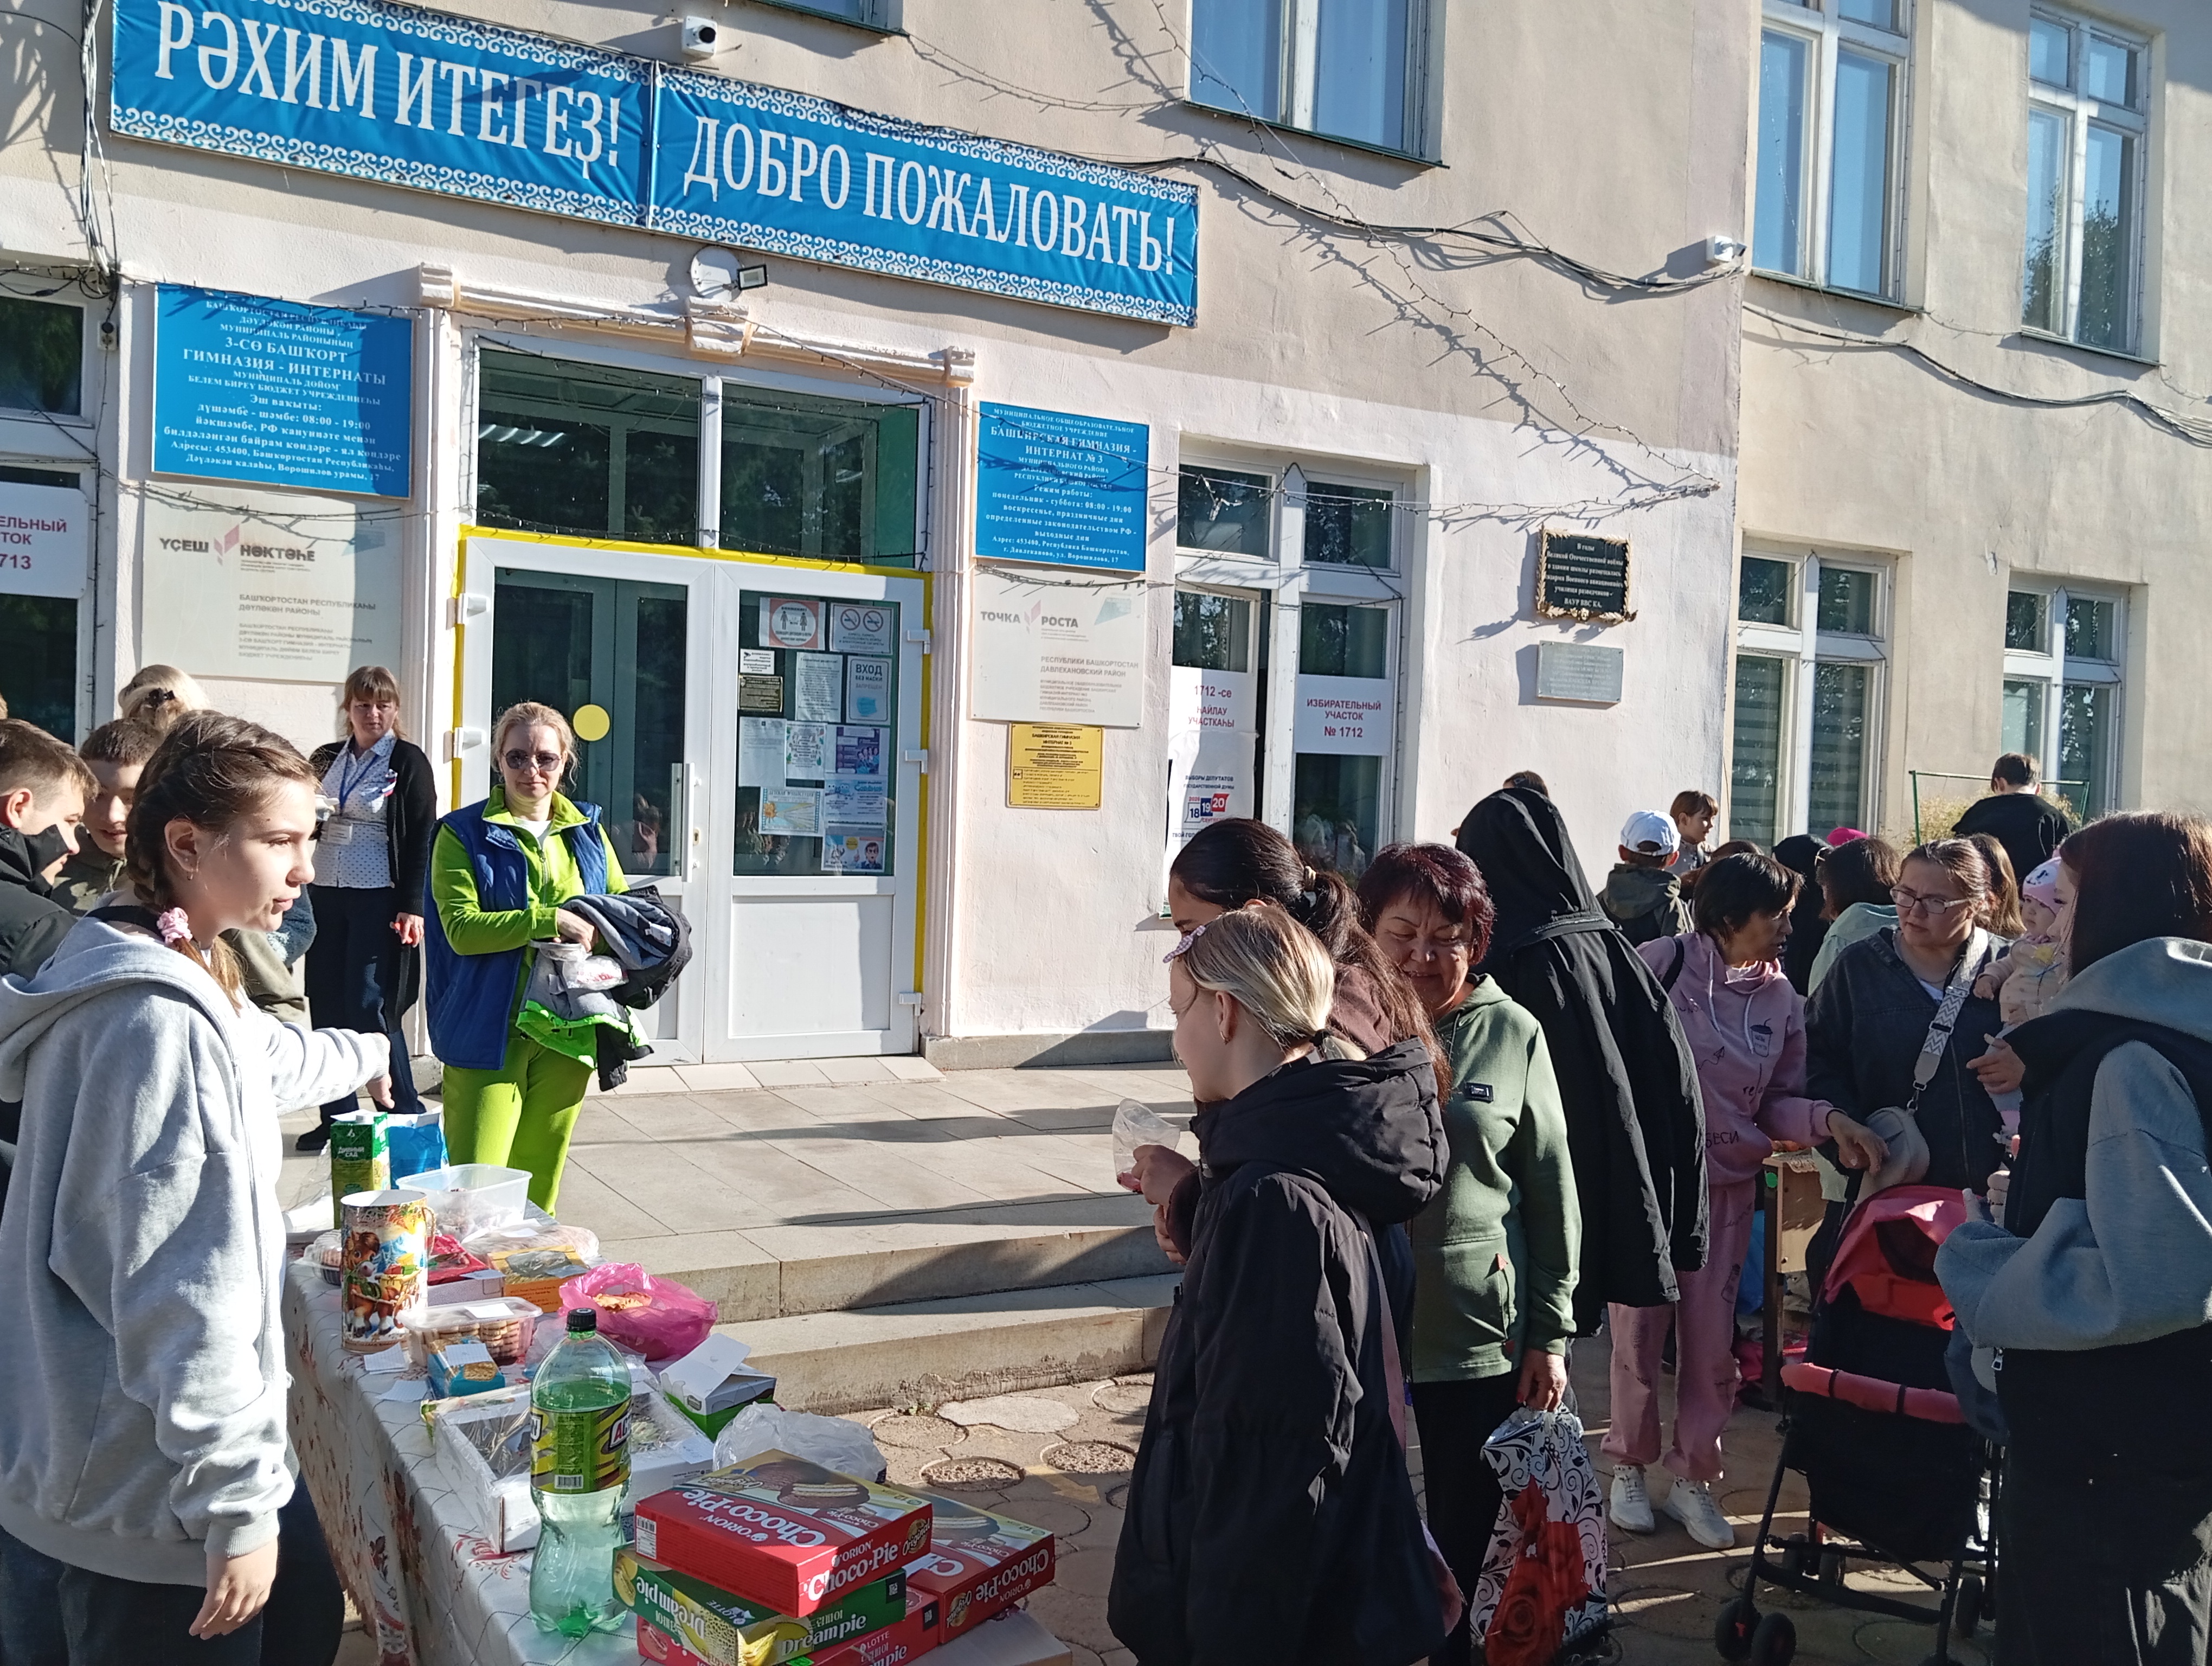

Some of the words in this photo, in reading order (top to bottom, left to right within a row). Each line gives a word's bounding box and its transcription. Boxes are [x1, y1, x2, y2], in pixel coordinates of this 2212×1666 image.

[155, 2, 378, 119] РӘХИМ
[395, 52, 621, 179] ИТЕГЕҘ!
[684, 116, 851, 210] ДОБРО
[864, 151, 1175, 275] ПОЖАЛОВАТЬ!
[184, 348, 274, 370] ГИМНАЗИЯ
[289, 362, 385, 385] ИНТЕРНАТЫ
[188, 375, 222, 386] БЕЛЕМ
[258, 383, 299, 395] БЮДЖЕТ
[250, 394, 268, 405] Эш
[994, 408, 1054, 422] МУНИЦИПАЛЬНОЕ
[260, 423, 278, 433] РФ
[303, 414, 332, 426] 08:00
[343, 419, 371, 431] 19:00
[170, 440, 212, 451] Адресы:
[215, 445, 250, 457] 453400,
[241, 434, 282, 448] байрам
[341, 447, 354, 456] ял
[1072, 437, 1130, 453] ГИМНАЗИЯ
[1026, 445, 1084, 461] ИНТЕРНАТ
[1085, 453, 1095, 463] №
[1097, 454, 1103, 464] 3
[278, 463, 332, 476] Ворошилов
[1084, 465, 1109, 473] РАЙОНА
[1034, 484, 1059, 494] Режим
[1062, 489, 1092, 498] работы:
[992, 492, 1044, 503] понедельник
[1051, 498, 1083, 508] суббота:
[1085, 501, 1105, 510] 08:00
[1113, 504, 1132, 513] 19:00
[1003, 504, 1054, 516] воскресенье,
[1056, 510, 1108, 522] праздничные
[986, 514, 1042, 526] определенные
[1045, 521, 1118, 534] законодательством
[1034, 530, 1073, 540] выходные
[992, 535, 1014, 543] Адрес:
[1042, 540, 1079, 550] Республика
[1569, 553, 1606, 564] Отечественной
[285, 606, 320, 616] РАЙОНЫ
[980, 611, 1021, 624] ТОЧКА
[1041, 616, 1078, 628] РОСТА
[1041, 656, 1084, 665] РЕСПУБЛИКИ
[1085, 659, 1139, 668] БАШКОРТОСТАН
[856, 664, 883, 676] ВХОД
[1040, 665, 1102, 675] ДАВЛЕКАНОВСКИЙ
[1104, 668, 1126, 677] РАЙОН
[1194, 685, 1216, 697] 1712
[1307, 699, 1381, 710] ИЗБИРАТЕЛЬНЫЙ
[1324, 710, 1364, 720] УЧАСТОК
[1324, 726, 1336, 736] №
[1339, 726, 1363, 738] 1712
[1189, 808, 1200, 818] 18
[1202, 802, 1211, 813] 19
[1212, 797, 1225, 808] 20
[338, 1146, 365, 1155] ДИВНЫЙ
[703, 1514, 754, 1537] ORION
[902, 1518, 931, 1556] Original
[841, 1541, 872, 1562] ORION
[867, 1630, 890, 1649] LOTTE
